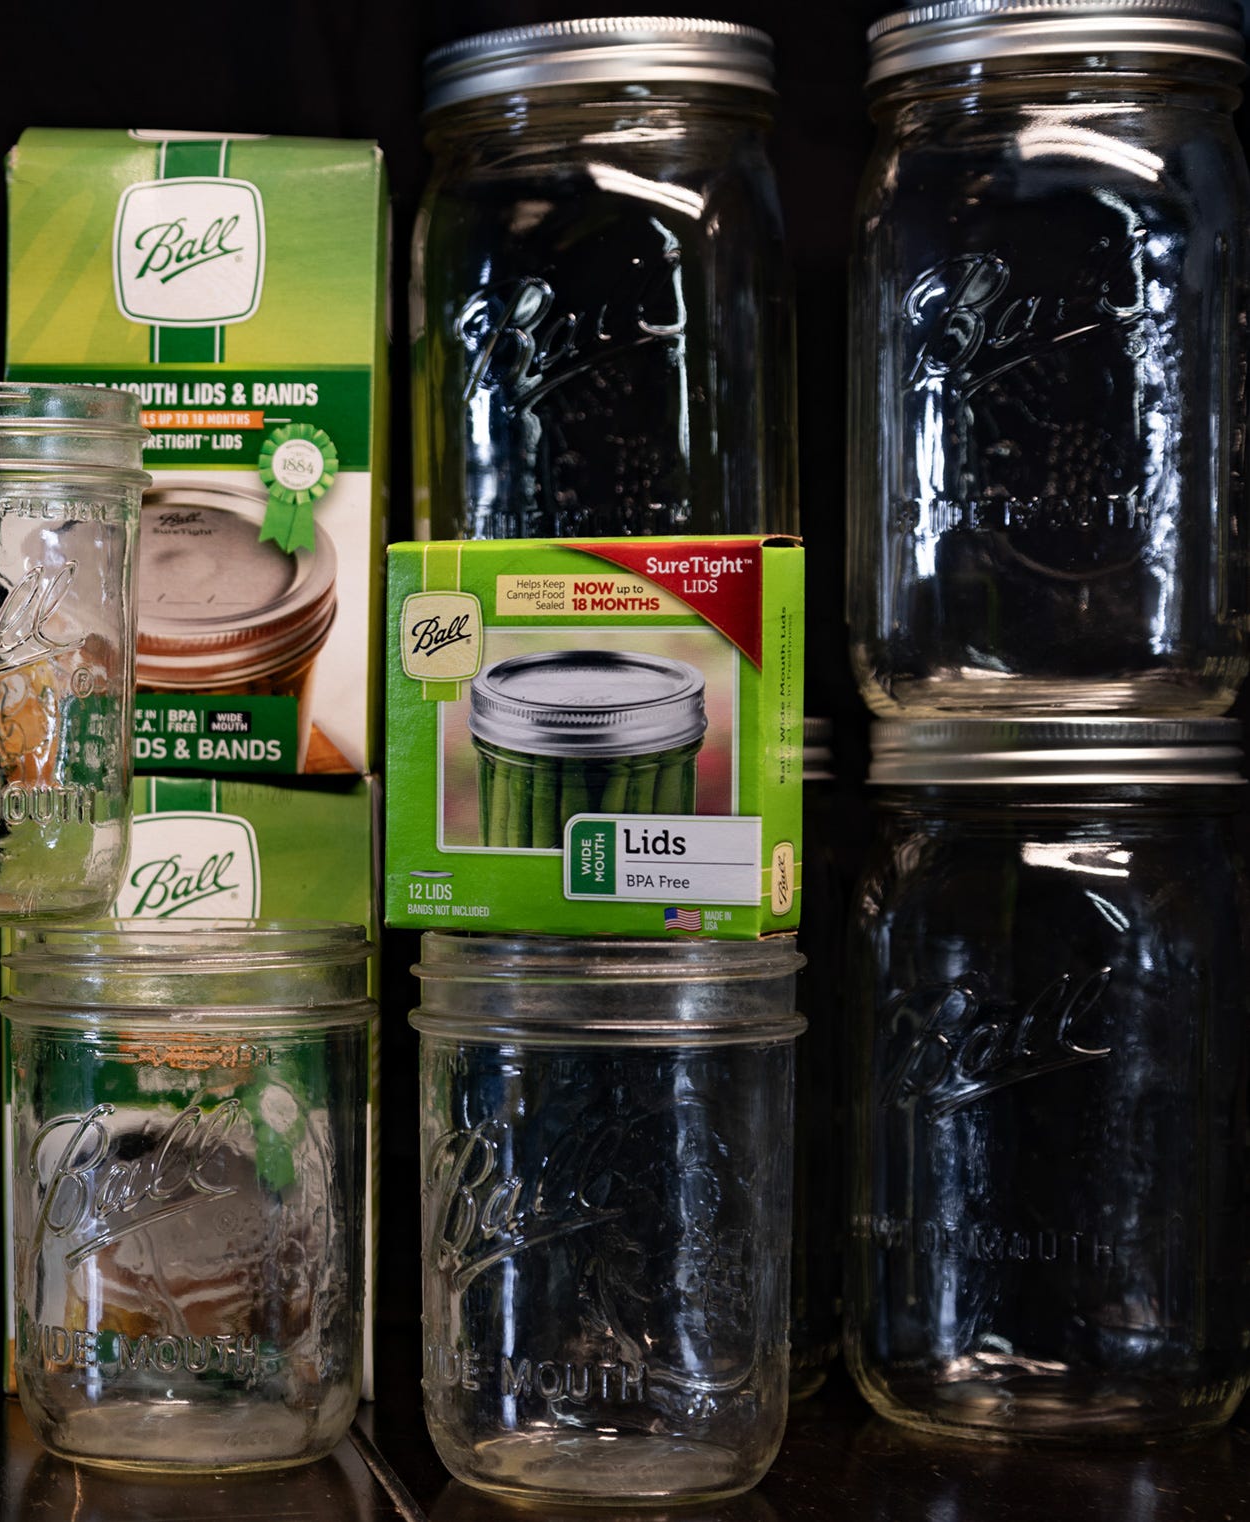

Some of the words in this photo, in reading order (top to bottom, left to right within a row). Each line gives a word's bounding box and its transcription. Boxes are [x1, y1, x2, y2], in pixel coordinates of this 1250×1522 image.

[134, 214, 244, 284] Ball
[183, 383, 226, 405] LIDS
[232, 384, 247, 404] &
[252, 383, 319, 406] BANDS
[159, 413, 173, 424] UP
[176, 413, 189, 424] TO
[192, 413, 204, 424] 18
[207, 413, 250, 424] MONTHS
[212, 434, 243, 450] LIDS
[282, 458, 314, 475] 1884
[159, 512, 205, 527] Ball
[516, 579, 541, 590] Helps
[543, 580, 565, 590] Keep
[574, 582, 615, 595] NOW
[617, 586, 631, 595] up
[633, 584, 643, 594] to
[683, 579, 718, 594] LIDS
[507, 590, 540, 600] Canned
[542, 591, 565, 600] Food
[536, 600, 565, 610] Sealed
[572, 598, 587, 611] 18
[591, 598, 660, 611] MONTHS
[411, 614, 472, 657] Ball
[145, 710, 157, 719] IN
[168, 710, 197, 722] BPA
[216, 713, 243, 722] WIDE
[168, 722, 198, 734] FREE
[211, 723, 248, 732] MOUTH
[135, 738, 167, 759] DS
[174, 738, 190, 760] &
[198, 739, 282, 761] BANDS
[624, 829, 687, 855] Lids
[581, 838, 593, 875] WIDE
[595, 833, 606, 882] MOUTH
[131, 851, 240, 917] Ball
[626, 874, 654, 888] BPA
[659, 875, 690, 889] Free
[408, 883, 423, 899] 12
[425, 884, 453, 900] LIDS
[408, 904, 433, 915] BANDS
[435, 905, 450, 915] NOT
[452, 906, 490, 917] INCLUDED
[704, 911, 723, 921] MADE
[725, 911, 732, 921] IN
[704, 921, 718, 931] USA
[878, 965, 1114, 1126] Ball
[29, 1099, 241, 1271] Ball
[118, 1333, 260, 1378] MOUTH
[424, 1345, 482, 1393] IDE
[500, 1359, 650, 1402] MOUTH
